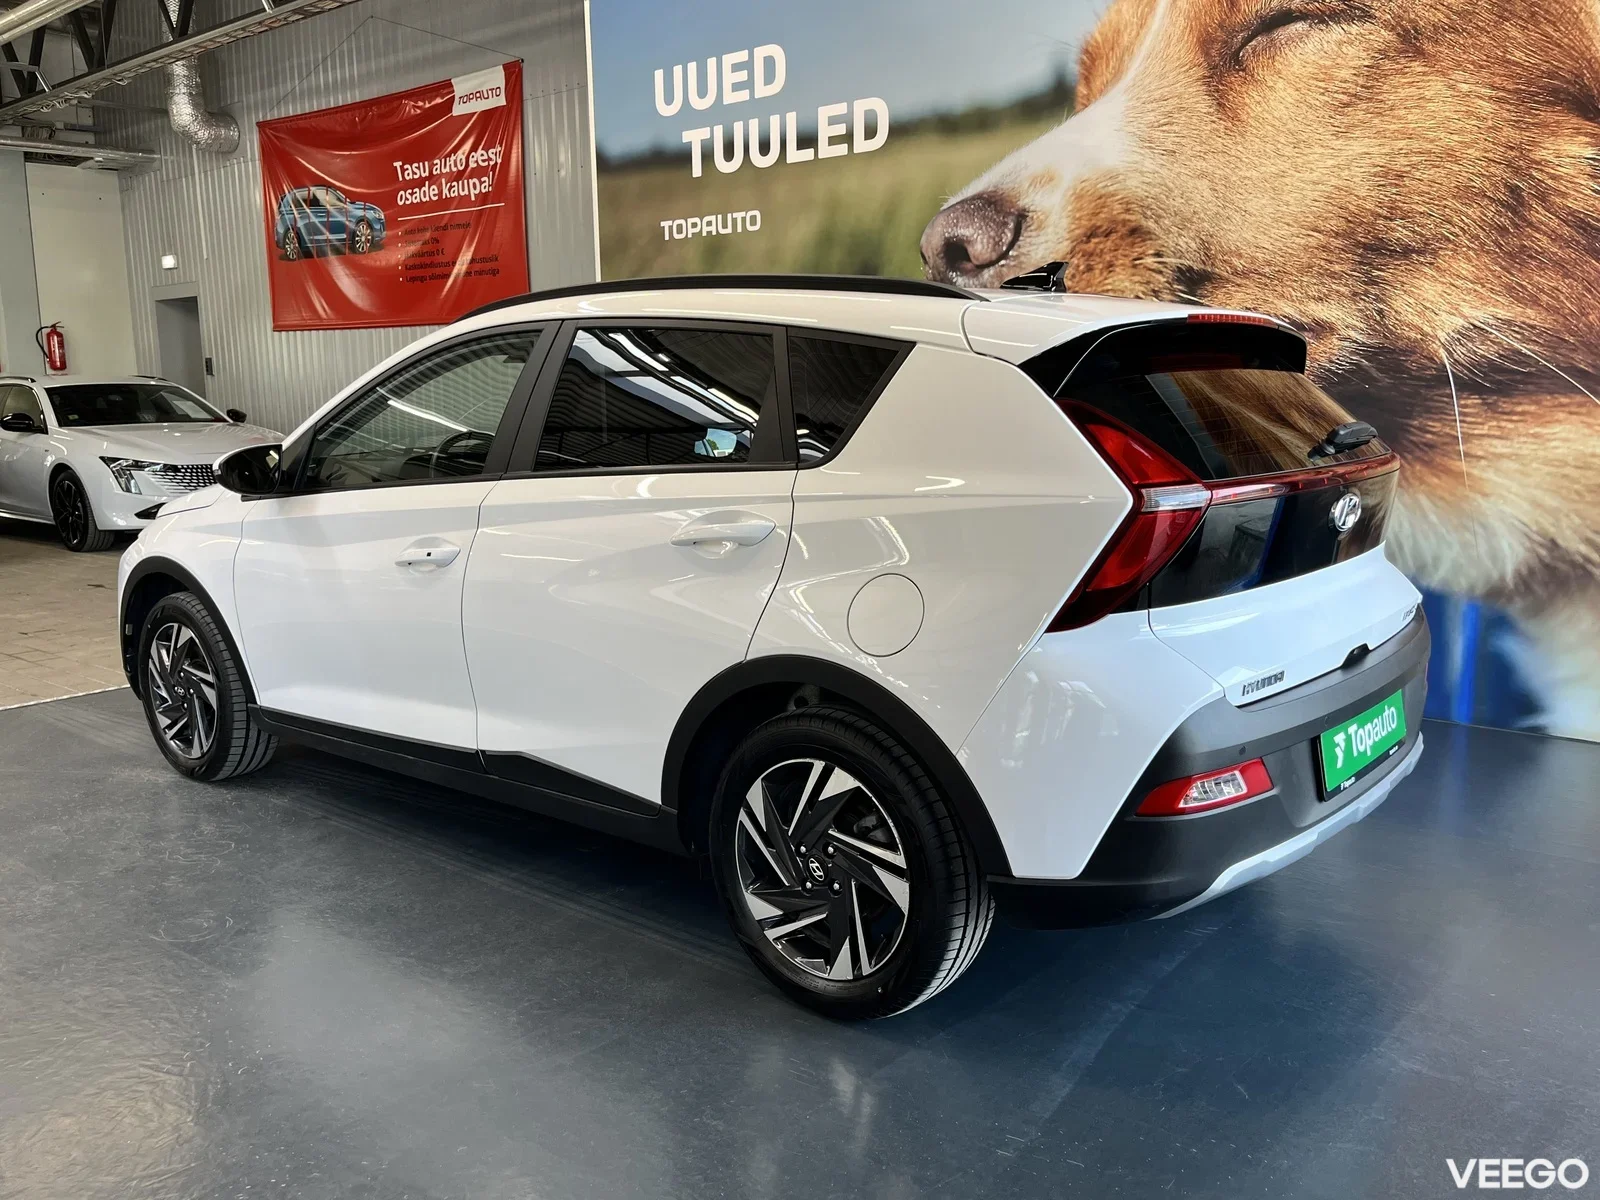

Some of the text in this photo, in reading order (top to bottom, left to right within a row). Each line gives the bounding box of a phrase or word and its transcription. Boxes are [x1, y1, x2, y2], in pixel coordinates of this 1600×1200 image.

[458, 86, 502, 105] TOPAUTO
[654, 44, 786, 117] UUED
[682, 97, 889, 178] TUULED
[393, 144, 502, 181] Tasu auto eest
[397, 171, 493, 206] osade kaupa!
[661, 210, 761, 240] TOPAUTO
[1242, 670, 1285, 697] HYUNDAI
[1347, 705, 1397, 757] Topauto
